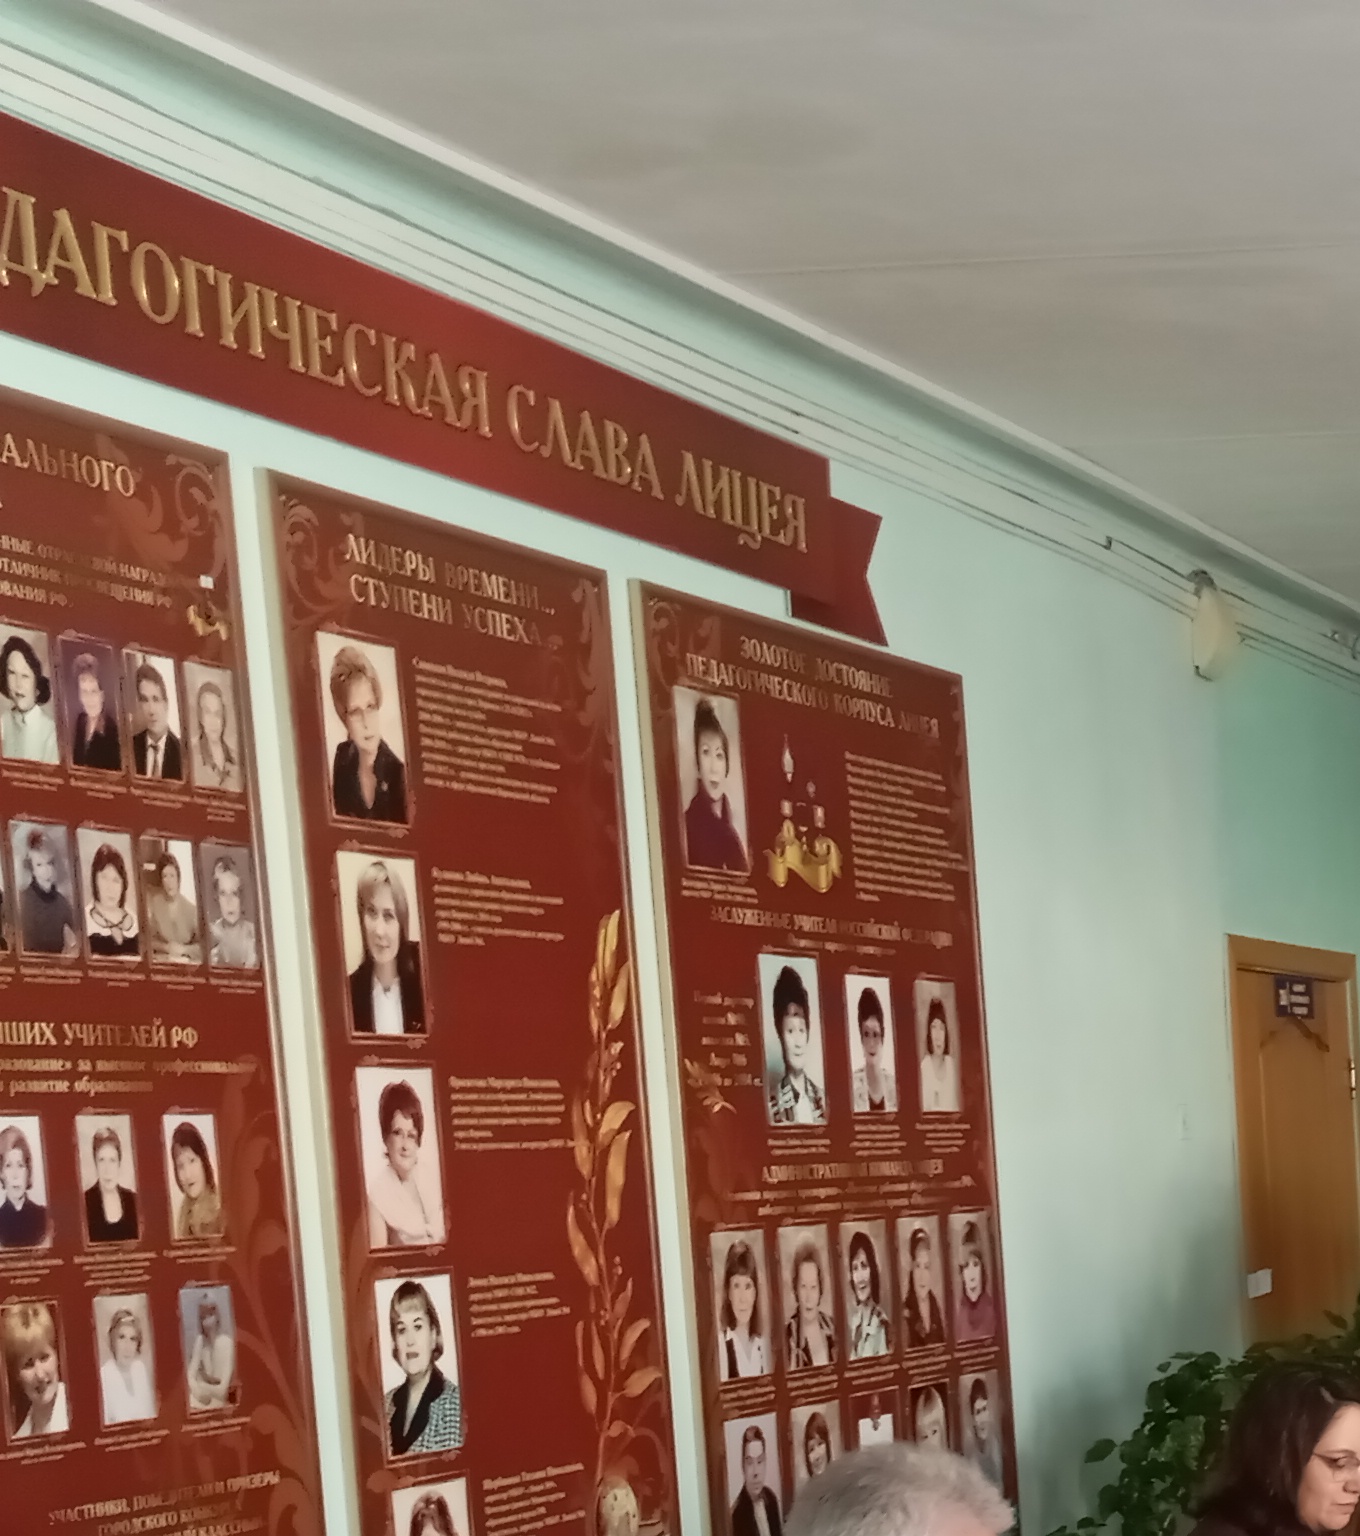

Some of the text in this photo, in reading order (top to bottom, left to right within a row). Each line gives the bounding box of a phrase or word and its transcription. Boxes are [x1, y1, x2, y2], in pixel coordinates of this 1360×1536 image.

[0, 185, 808, 552] ДАГОГИЧЕСКАЯ СЛАВА ЛИЦЕЯ
[344, 533, 436, 584] ЛИДЕРЫ
[349, 573, 542, 647] СТУПЕНИ УСПЕХА
[739, 635, 808, 674] ЗОЛОТОЕ
[63, 1017, 167, 1048] УЧИТЕЛЕЙ
[170, 1026, 199, 1048] РФ
